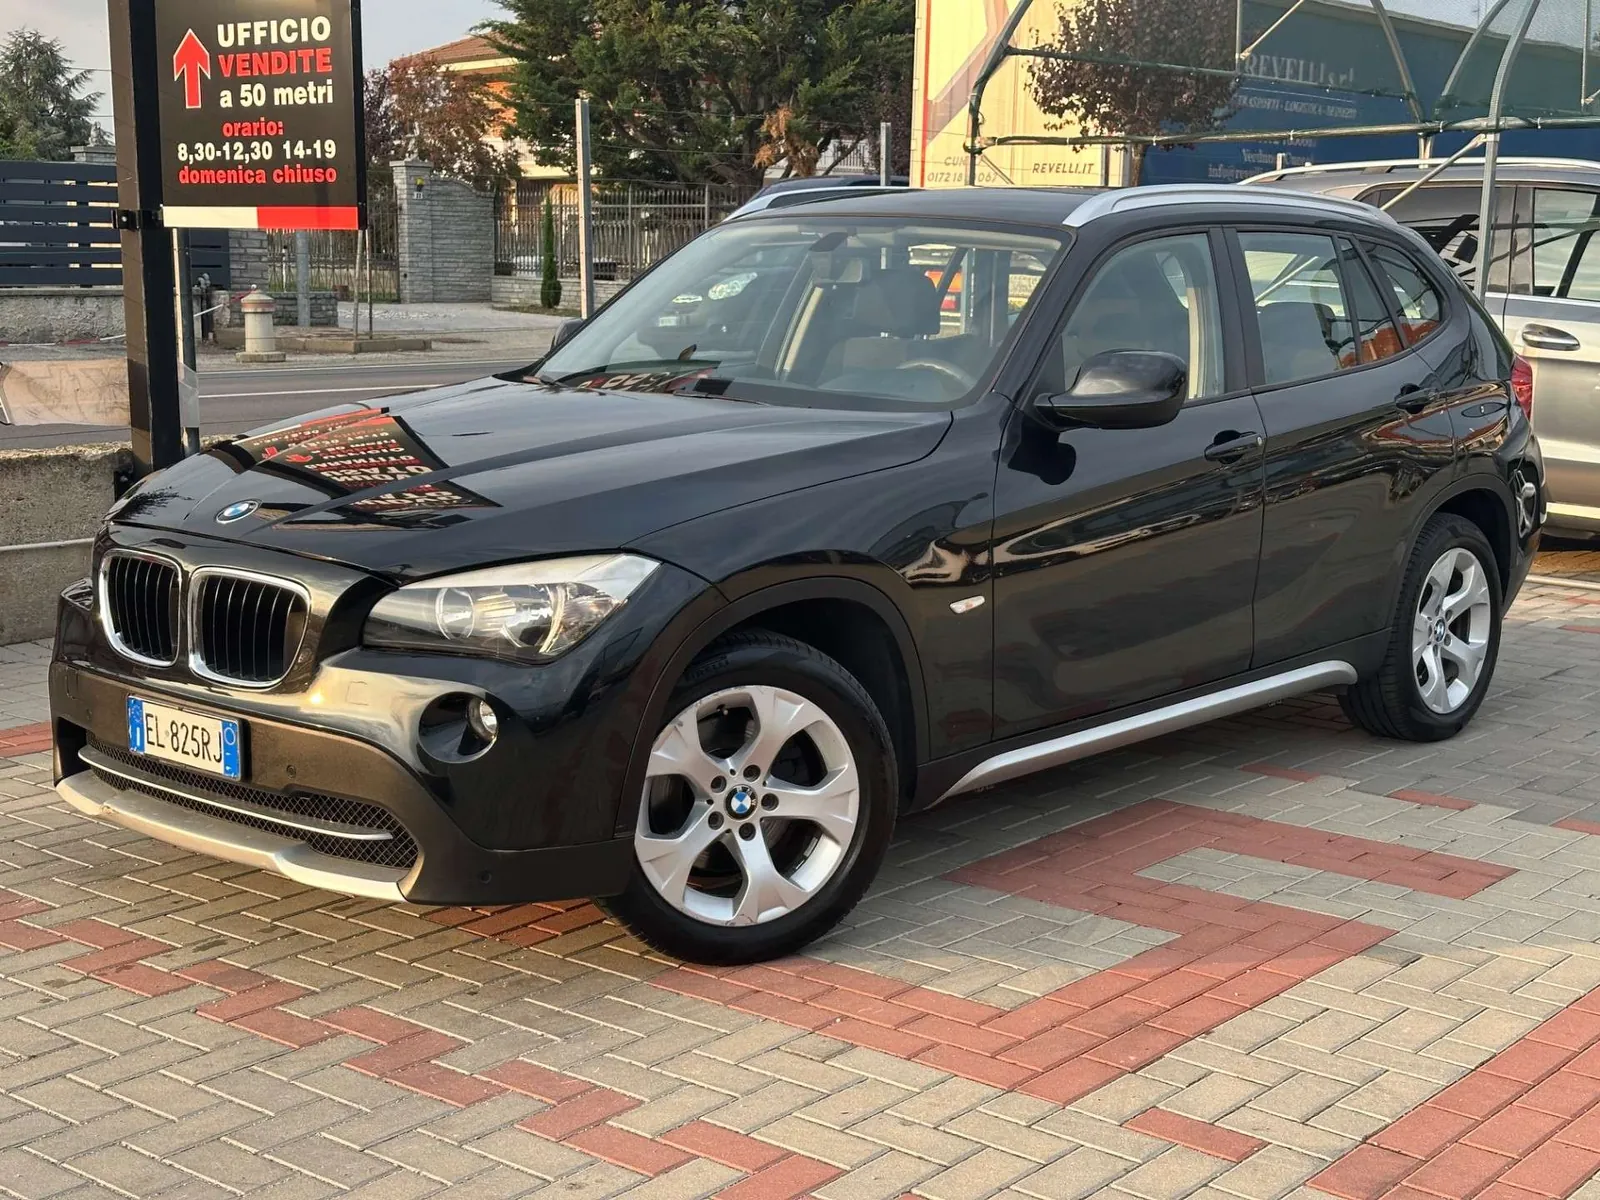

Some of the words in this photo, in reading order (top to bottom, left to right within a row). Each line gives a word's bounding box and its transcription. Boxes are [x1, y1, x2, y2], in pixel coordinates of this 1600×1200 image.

[217, 16, 331, 47] UFFICIO
[218, 48, 332, 77] VENDITE
[219, 89, 233, 108] a
[239, 83, 266, 107] 50
[273, 79, 333, 105] metri
[222, 117, 284, 137] orario:
[177, 141, 272, 164] 8,30-12,30
[283, 139, 336, 159] 14-19
[178, 165, 266, 184] domenica
[272, 164, 337, 183] chiuso
[927, 172, 951, 182] 0172
[1032, 163, 1095, 174] REVELLI.IT
[145, 713, 165, 749] EL
[170, 720, 222, 763] 825RJ
